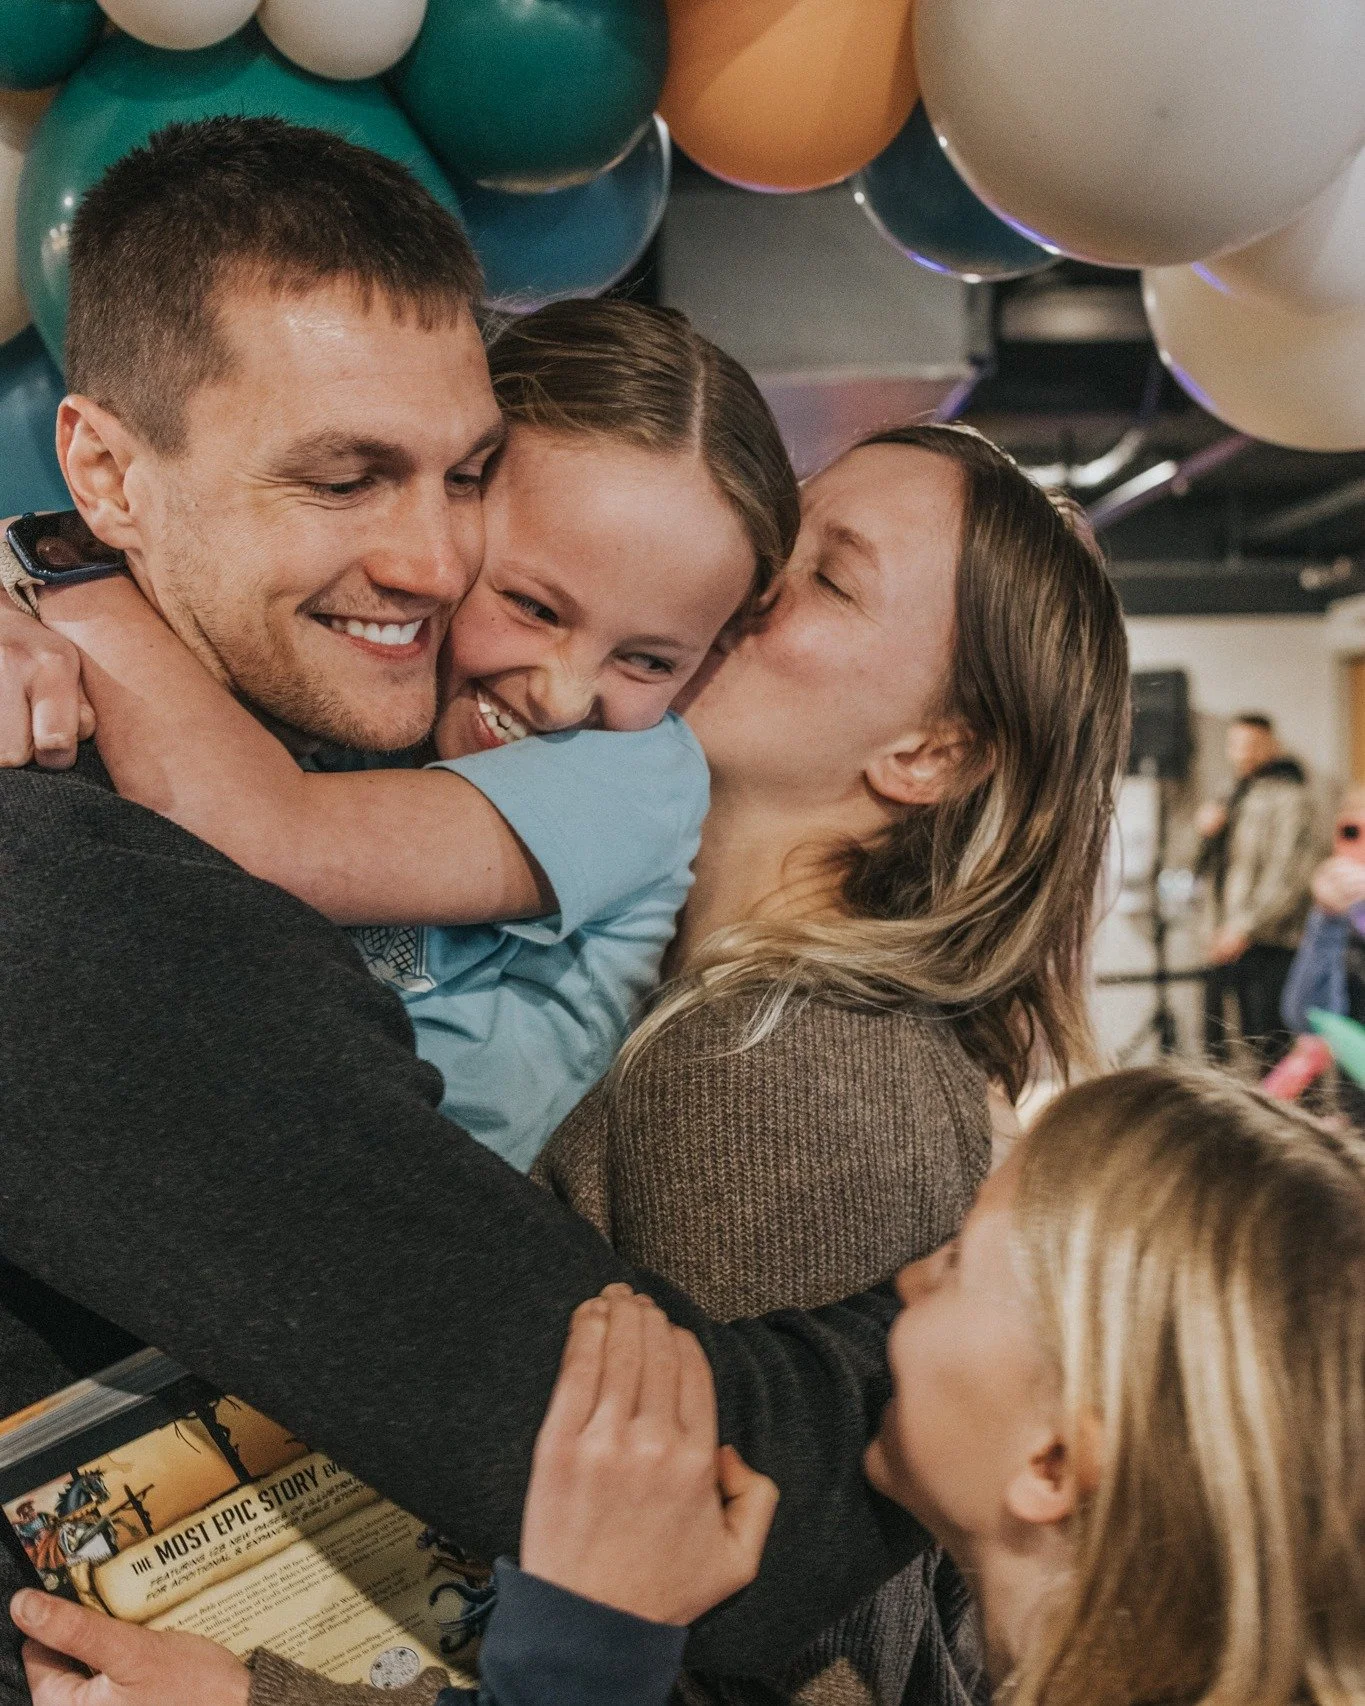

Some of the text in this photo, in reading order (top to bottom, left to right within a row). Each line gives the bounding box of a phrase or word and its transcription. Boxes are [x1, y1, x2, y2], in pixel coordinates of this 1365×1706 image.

[130, 1555, 154, 1576] THE
[152, 1519, 213, 1566] MOST
[210, 1496, 259, 1536] EPIC
[255, 1463, 323, 1513] STORY
[144, 1584, 168, 1601] FOR
[169, 1552, 231, 1588] ADDITIONAL
[233, 1546, 242, 1555] &
[244, 1516, 300, 1549] EXPANDED
[148, 1553, 206, 1587] FEATURING
[207, 1542, 227, 1557] 128
[228, 1528, 252, 1546] NEW
[251, 1510, 288, 1534] PAGES
[288, 1500, 308, 1515] OF
